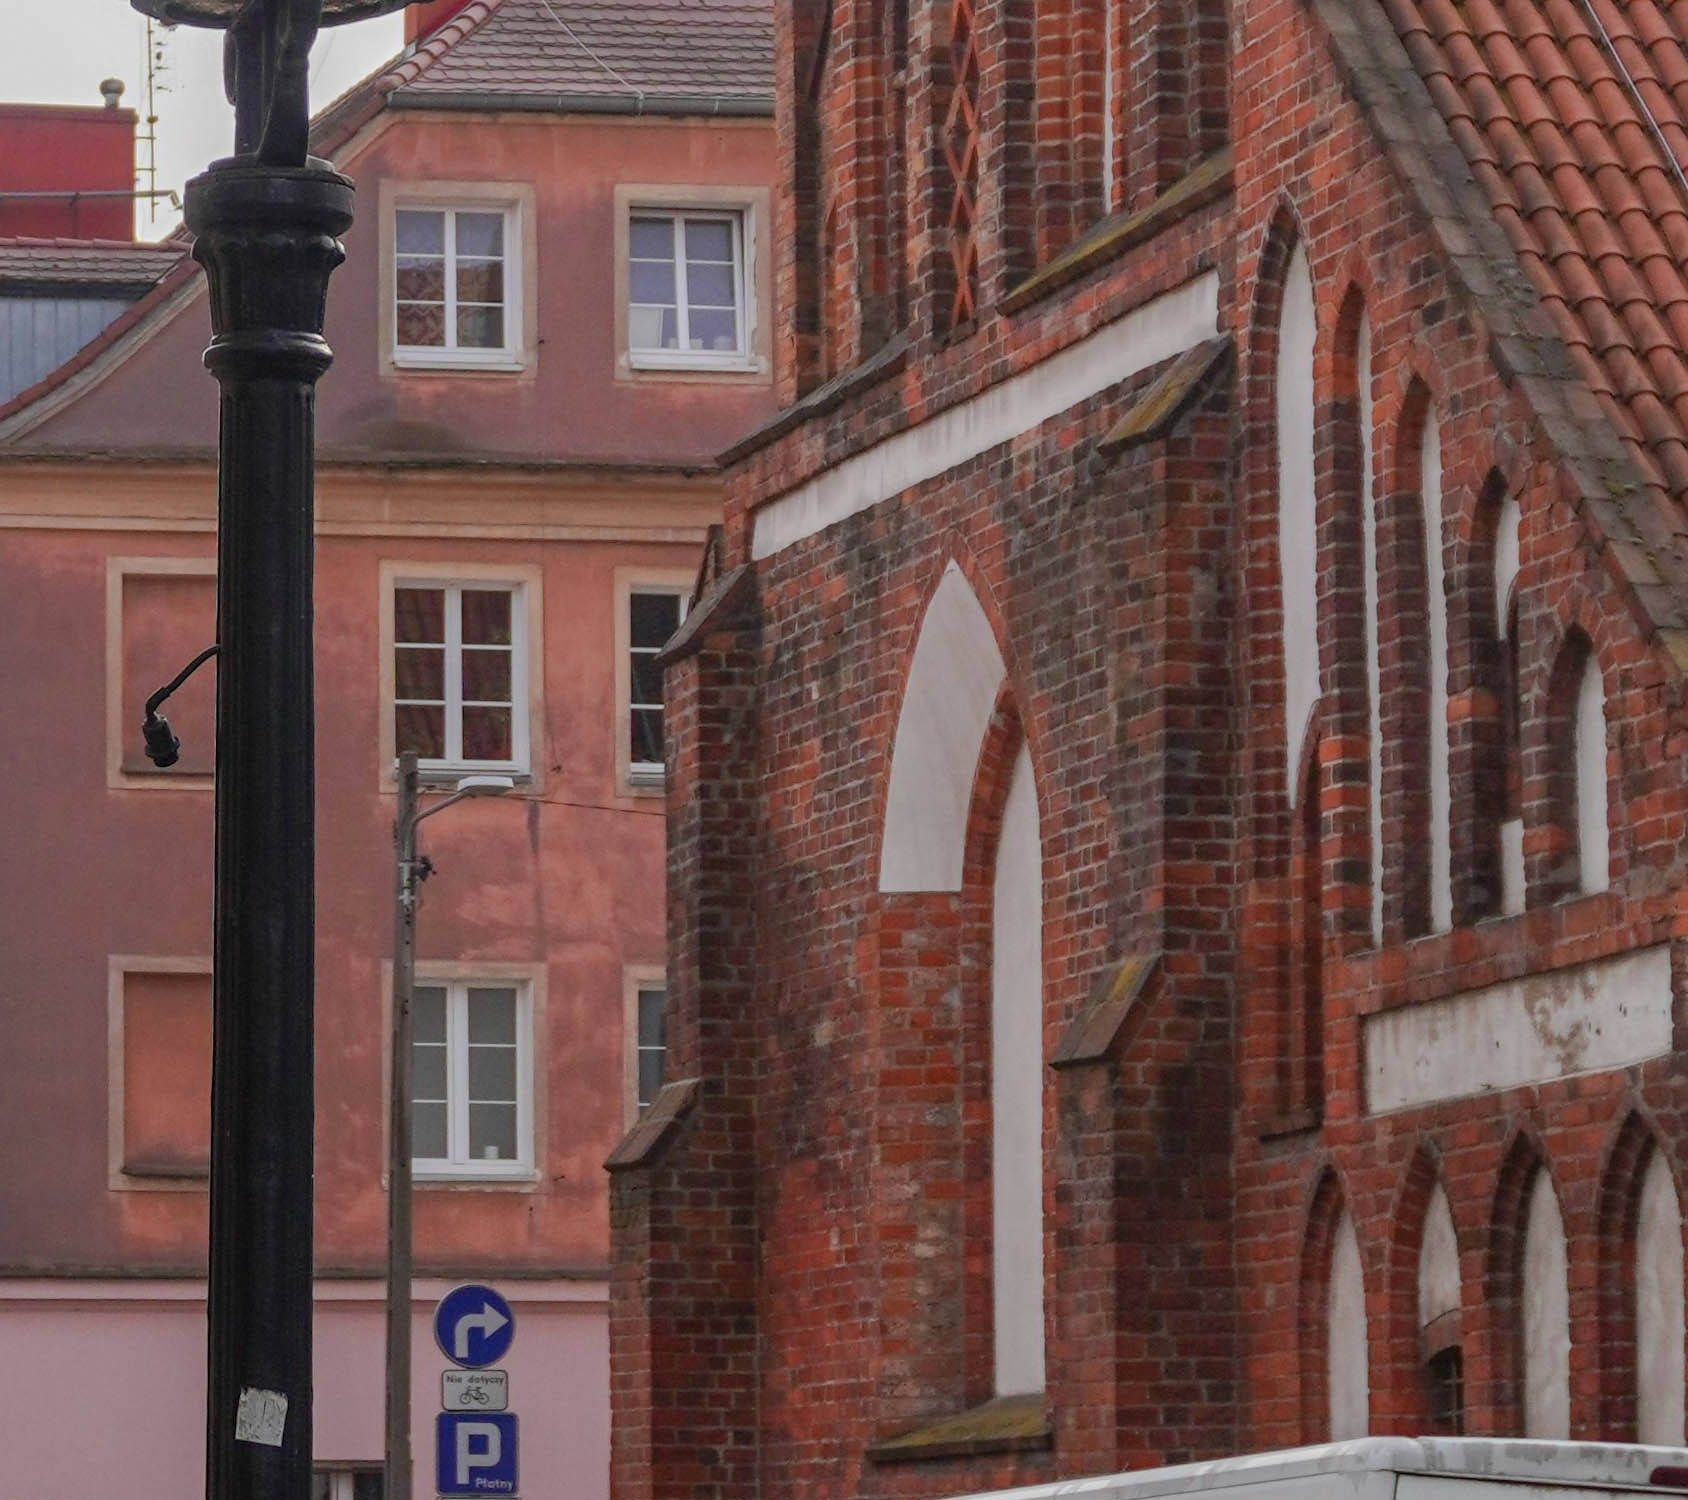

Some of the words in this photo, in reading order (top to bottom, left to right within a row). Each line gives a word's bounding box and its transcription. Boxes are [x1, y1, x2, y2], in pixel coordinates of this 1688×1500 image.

[446, 1375, 463, 1384] Nie
[467, 1374, 505, 1386] dotyczy
[455, 1422, 502, 1485] P
